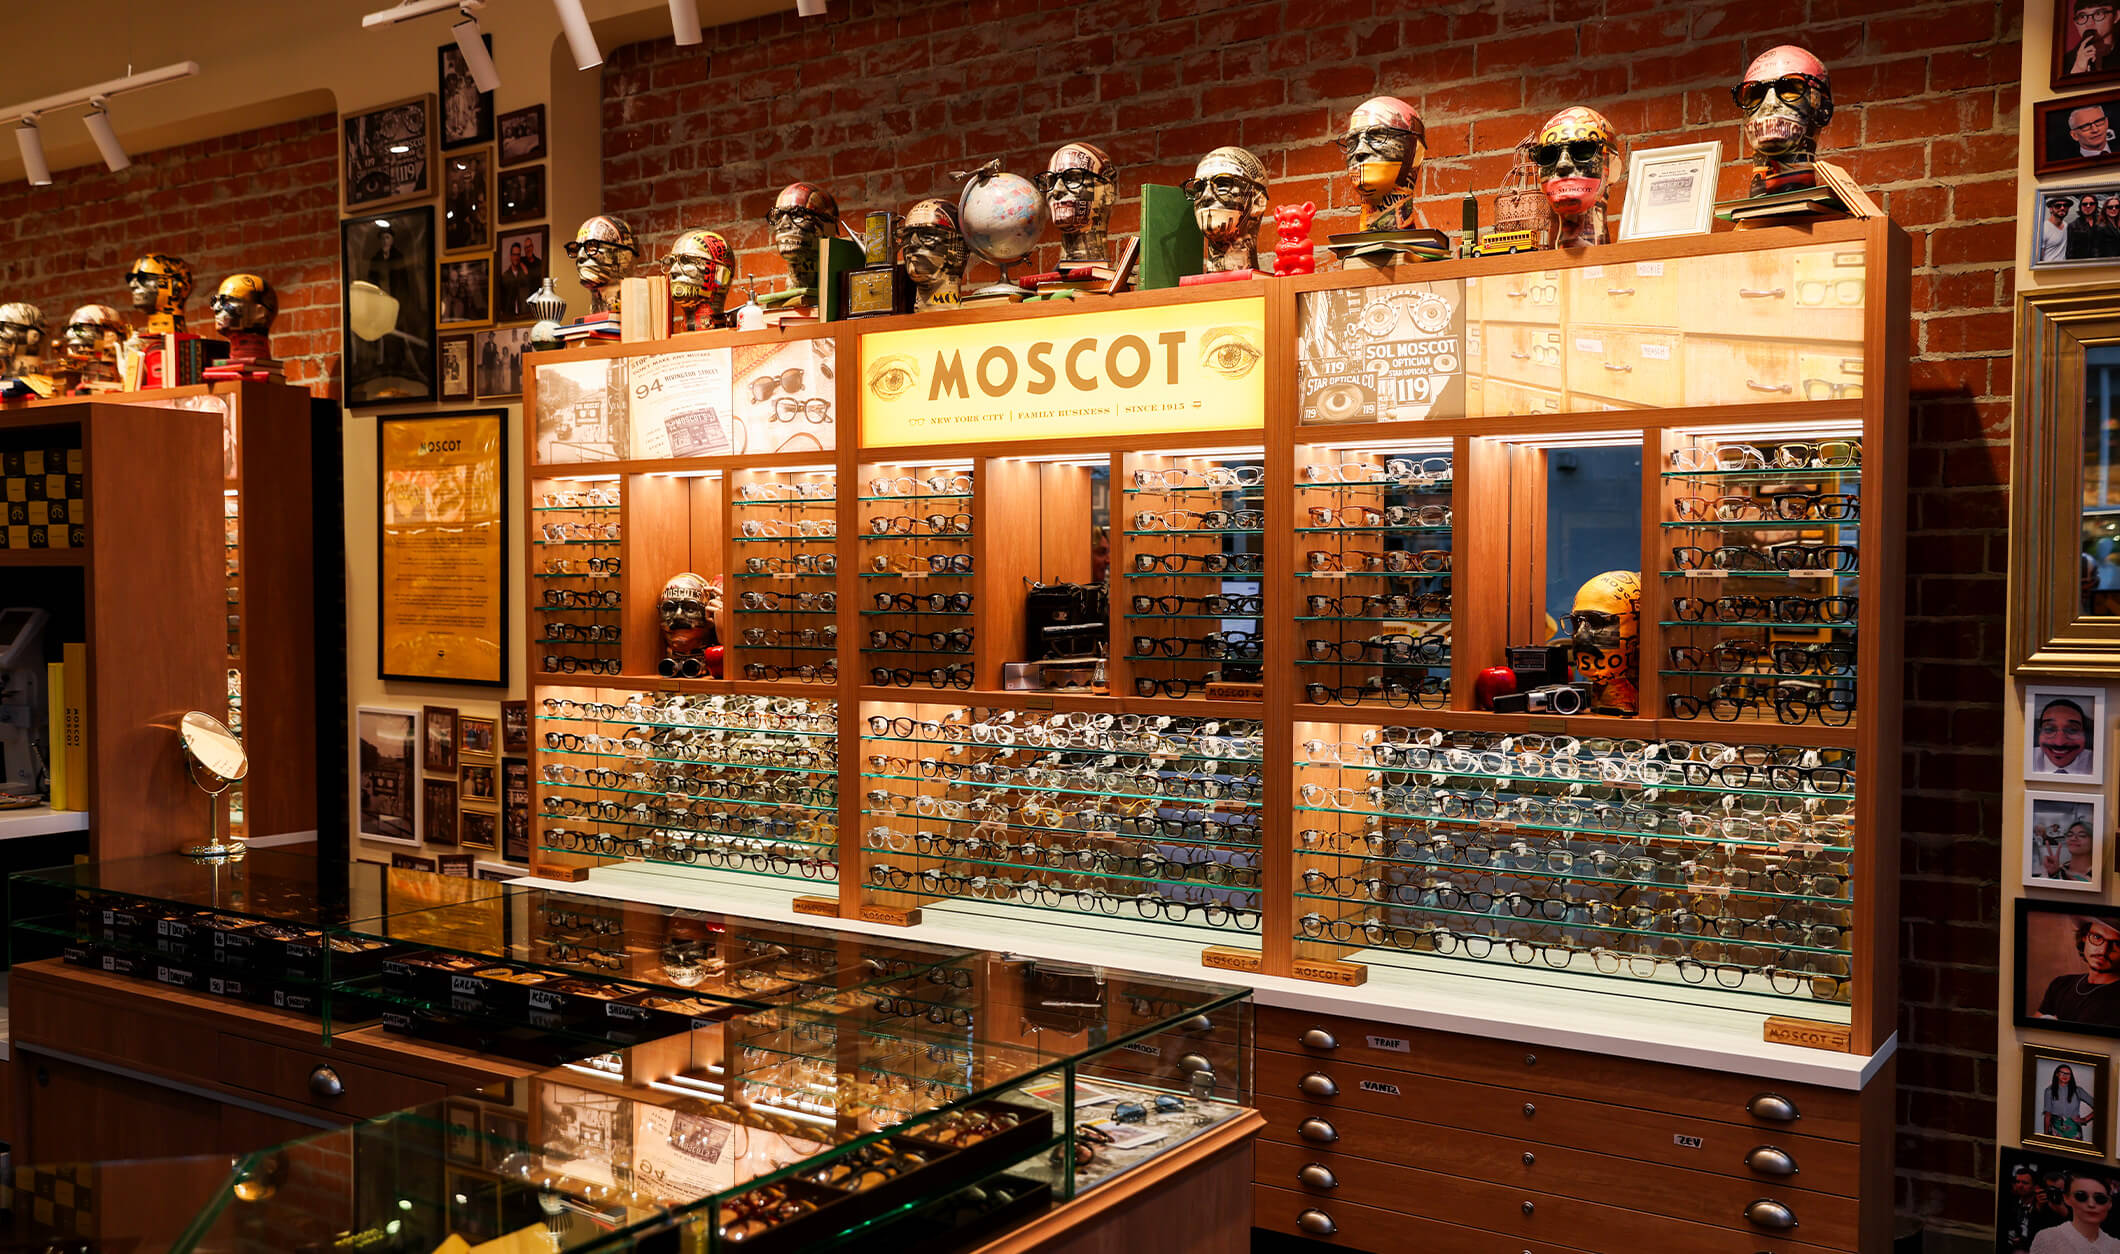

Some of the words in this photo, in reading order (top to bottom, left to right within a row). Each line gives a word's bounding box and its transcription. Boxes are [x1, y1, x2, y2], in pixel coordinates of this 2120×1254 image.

[397, 163, 415, 182] 119
[1366, 345, 1396, 360] SOL
[1397, 339, 1455, 357] MOSCOT
[631, 357, 648, 370] STOP
[652, 357, 670, 366] MAKE
[928, 330, 1186, 402] MOSCOT
[1325, 361, 1345, 374] 119
[1392, 357, 1431, 368] OPTICIAN
[664, 372, 697, 382] RIVINGTON
[698, 368, 719, 377] STREET
[1389, 369, 1403, 377] STAR
[1403, 368, 1428, 376] OPTICAL
[635, 378, 664, 400] 94
[1306, 377, 1328, 396] STAR
[1329, 375, 1361, 385] OPTICAL
[1361, 374, 1377, 392] CO.
[1397, 377, 1430, 403] 119
[1017, 410, 1055, 420] FAMILY
[1058, 407, 1111, 418] BUSINESS
[1124, 404, 1158, 413] SINCE
[1160, 402, 1185, 412] 1915
[1304, 407, 1317, 419] 119
[1363, 404, 1375, 415] 119
[930, 417, 952, 425] NEW
[953, 415, 980, 424] YORK
[981, 412, 1004, 422] CITY
[421, 440, 462, 453] MOSCOT
[1209, 688, 1250, 697] MOSCOT
[862, 912, 895, 921] MOSCOT
[1206, 955, 1246, 968] MOSCOT
[1295, 967, 1339, 980] MOSCOT
[1770, 1028, 1826, 1044] MOSCOT
[1374, 1038, 1400, 1049] TRAIF
[1364, 1082, 1398, 1094] VANTZ
[1677, 1135, 1701, 1147] ZEV
